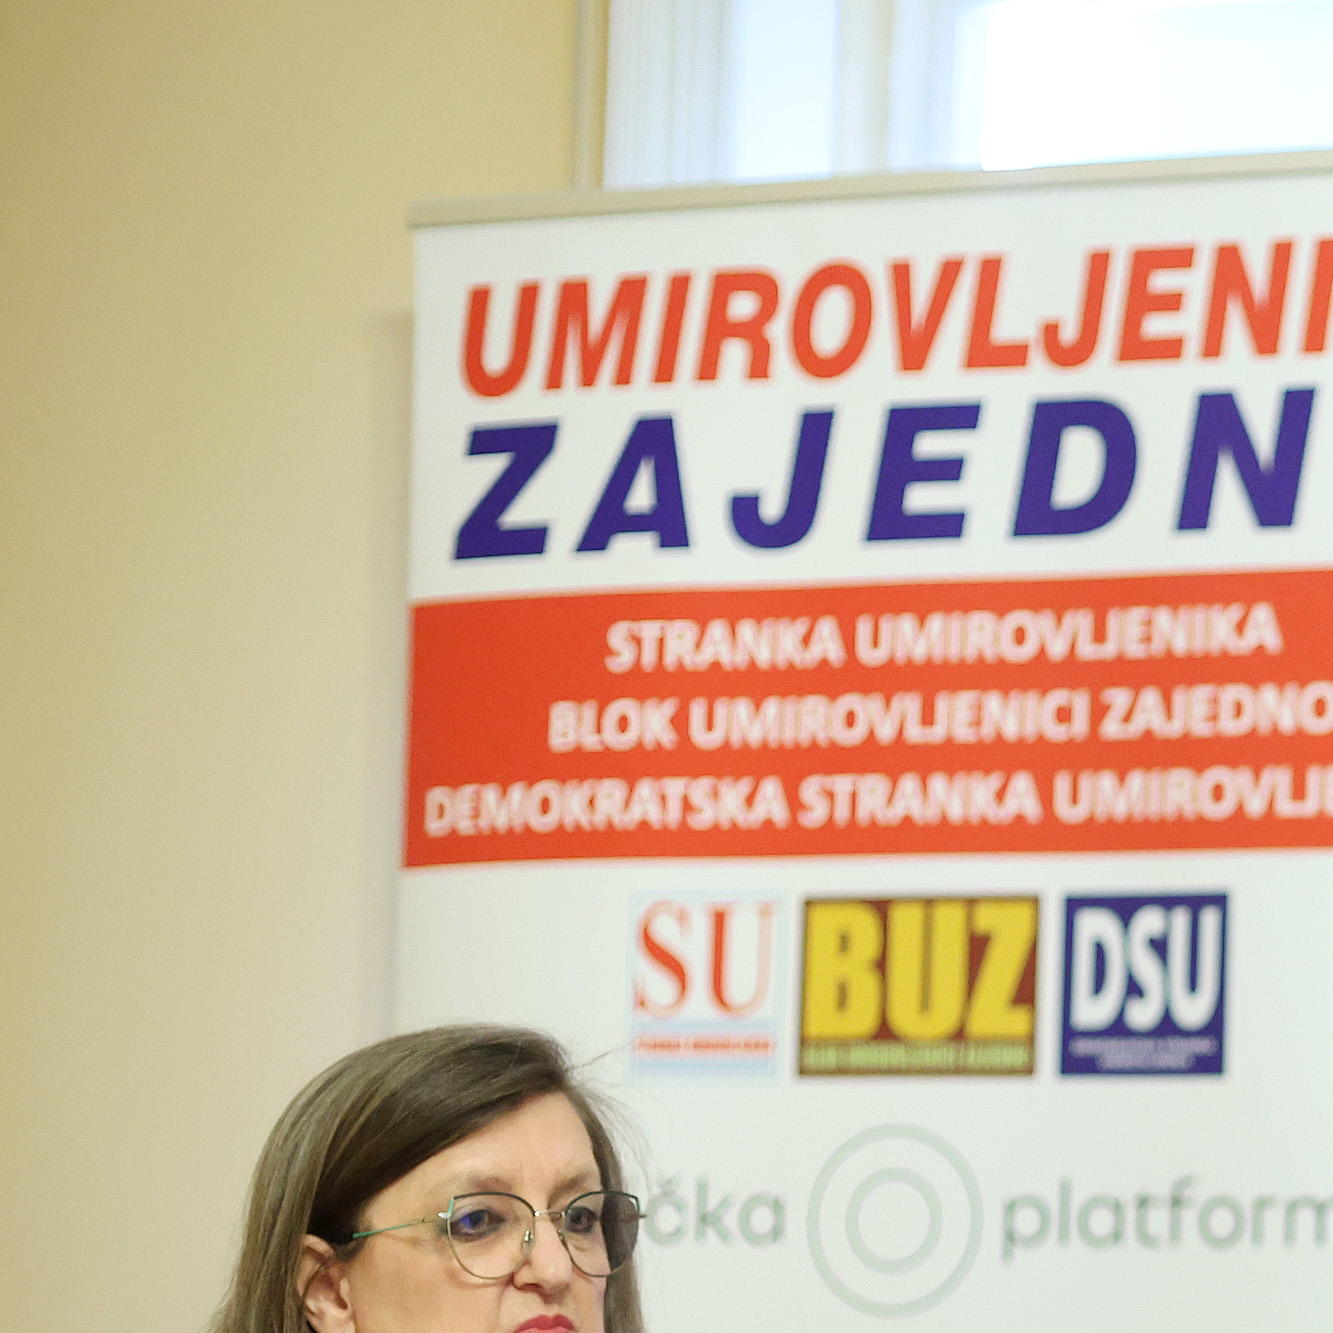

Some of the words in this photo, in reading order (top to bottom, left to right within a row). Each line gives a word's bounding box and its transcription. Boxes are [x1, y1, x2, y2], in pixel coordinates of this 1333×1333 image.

[605, 617, 844, 673] STRANKA
[855, 600, 1282, 667] UMIROVLJENIKA
[549, 698, 677, 752] BLOK
[687, 689, 1089, 749] UMIROVLJENICI
[423, 776, 789, 837] DEMOKRATSKA
[798, 772, 1040, 828] STRANKA
[633, 900, 776, 1017] SU
[806, 900, 1035, 1040] BUZ
[1070, 904, 1222, 1032] DSU
